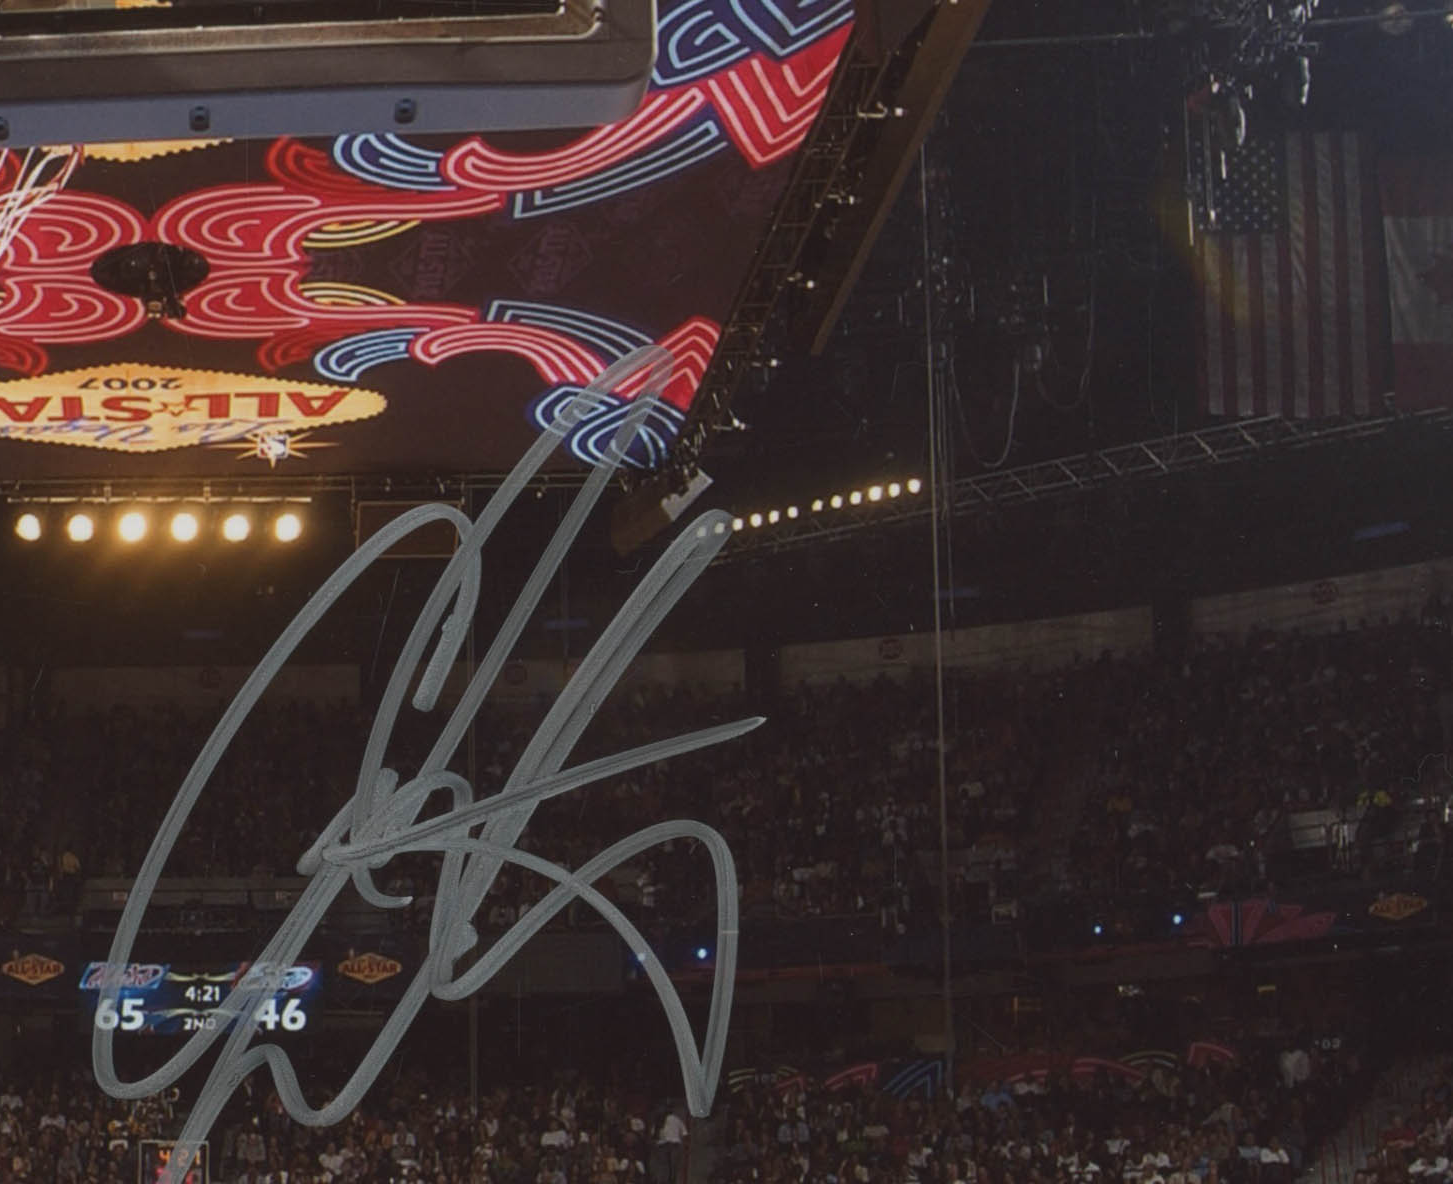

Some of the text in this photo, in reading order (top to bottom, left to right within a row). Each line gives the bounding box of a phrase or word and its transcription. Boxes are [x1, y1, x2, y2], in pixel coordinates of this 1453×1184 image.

[77, 376, 183, 391] 2007
[184, 986, 220, 1002] 4:21
[95, 998, 145, 1032] 65
[254, 998, 307, 1032] 46
[183, 1017, 218, 1031] 2ND
